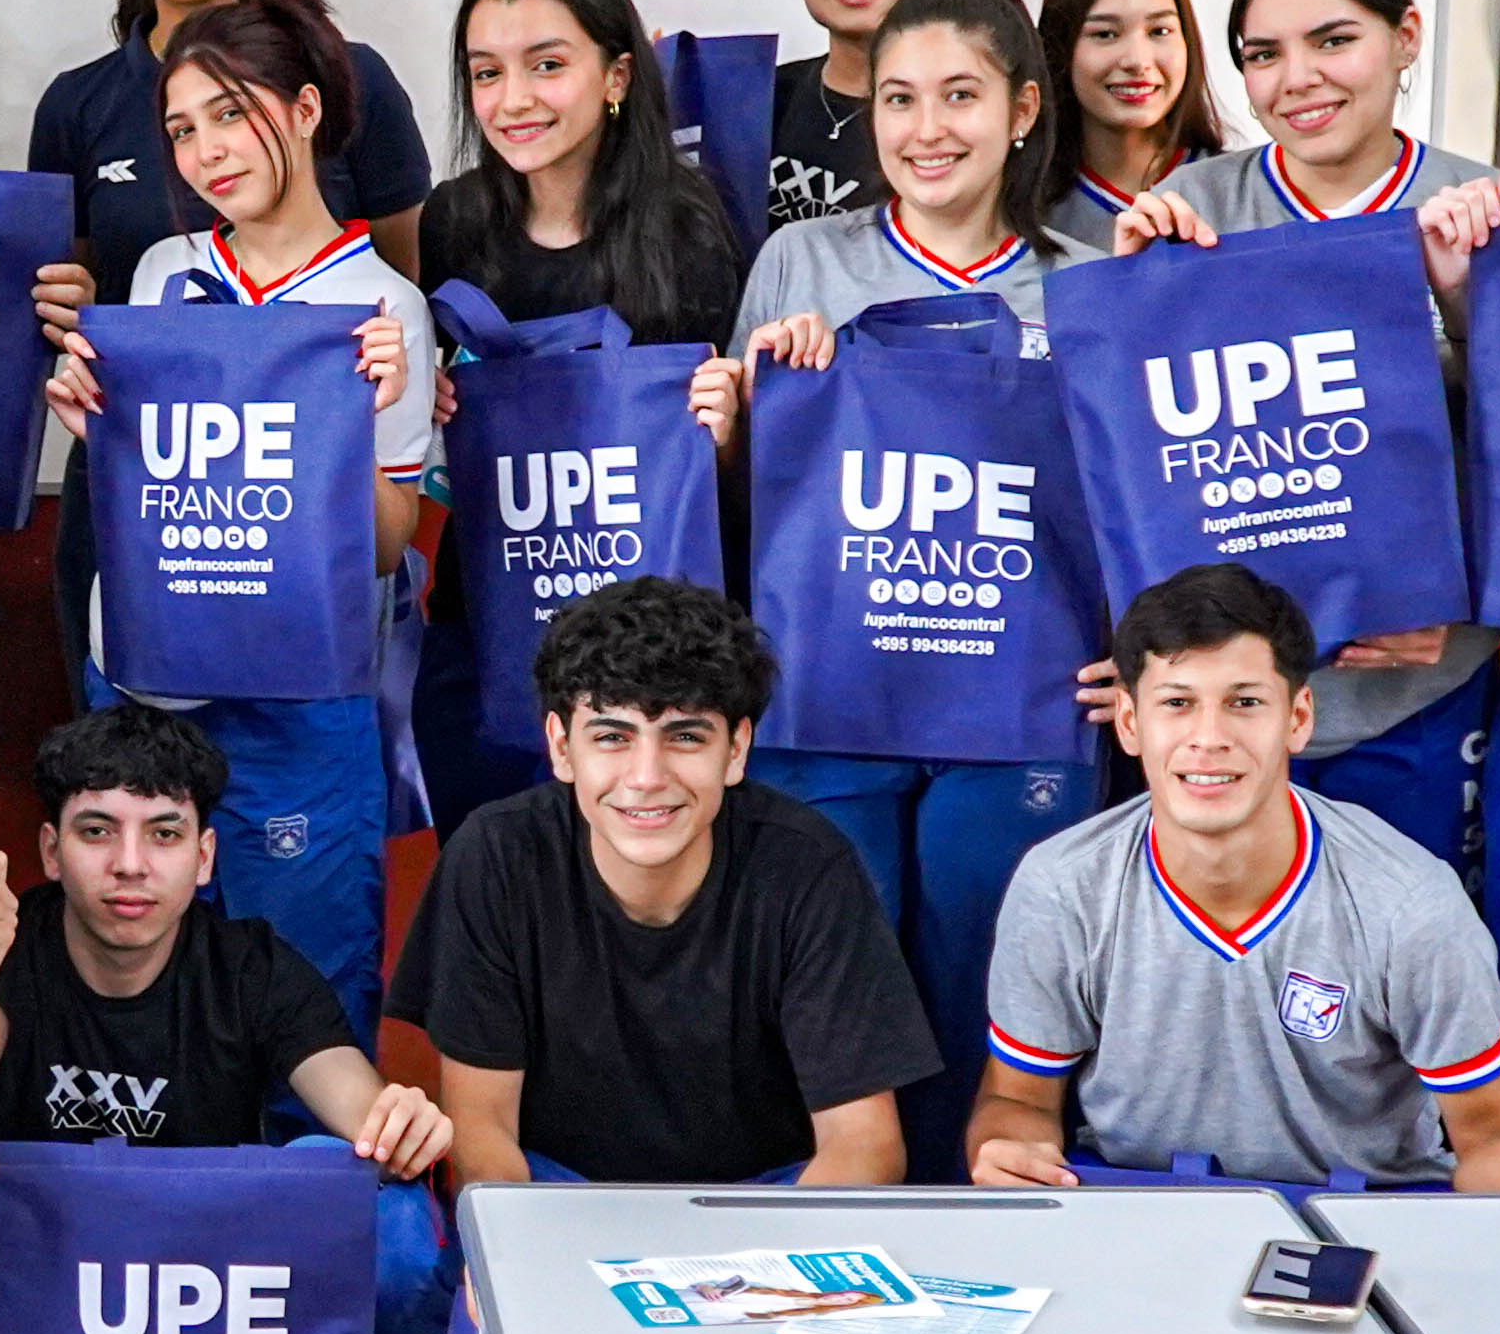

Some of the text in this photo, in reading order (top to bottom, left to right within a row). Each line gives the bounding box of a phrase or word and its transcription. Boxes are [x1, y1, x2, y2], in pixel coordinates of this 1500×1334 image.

[1145, 329, 1366, 438] UPE
[140, 402, 295, 481] UPE
[1162, 416, 1369, 483] FRANCO
[141, 484, 292, 521] FRANCO
[497, 446, 641, 532] UPE
[840, 450, 1036, 541] UPE
[1203, 497, 1352, 533] /upefrancocentral
[503, 529, 642, 572] FRANCO
[841, 536, 1033, 581] FRANCO
[1217, 522, 1347, 554] +595 994364238
[158, 556, 273, 574] /upefrancocentral
[167, 579, 267, 596] +595 994364238
[864, 612, 1006, 634] /upefrancocentral
[872, 635, 995, 655] +595 994364238
[46, 1064, 169, 1111] XXV
